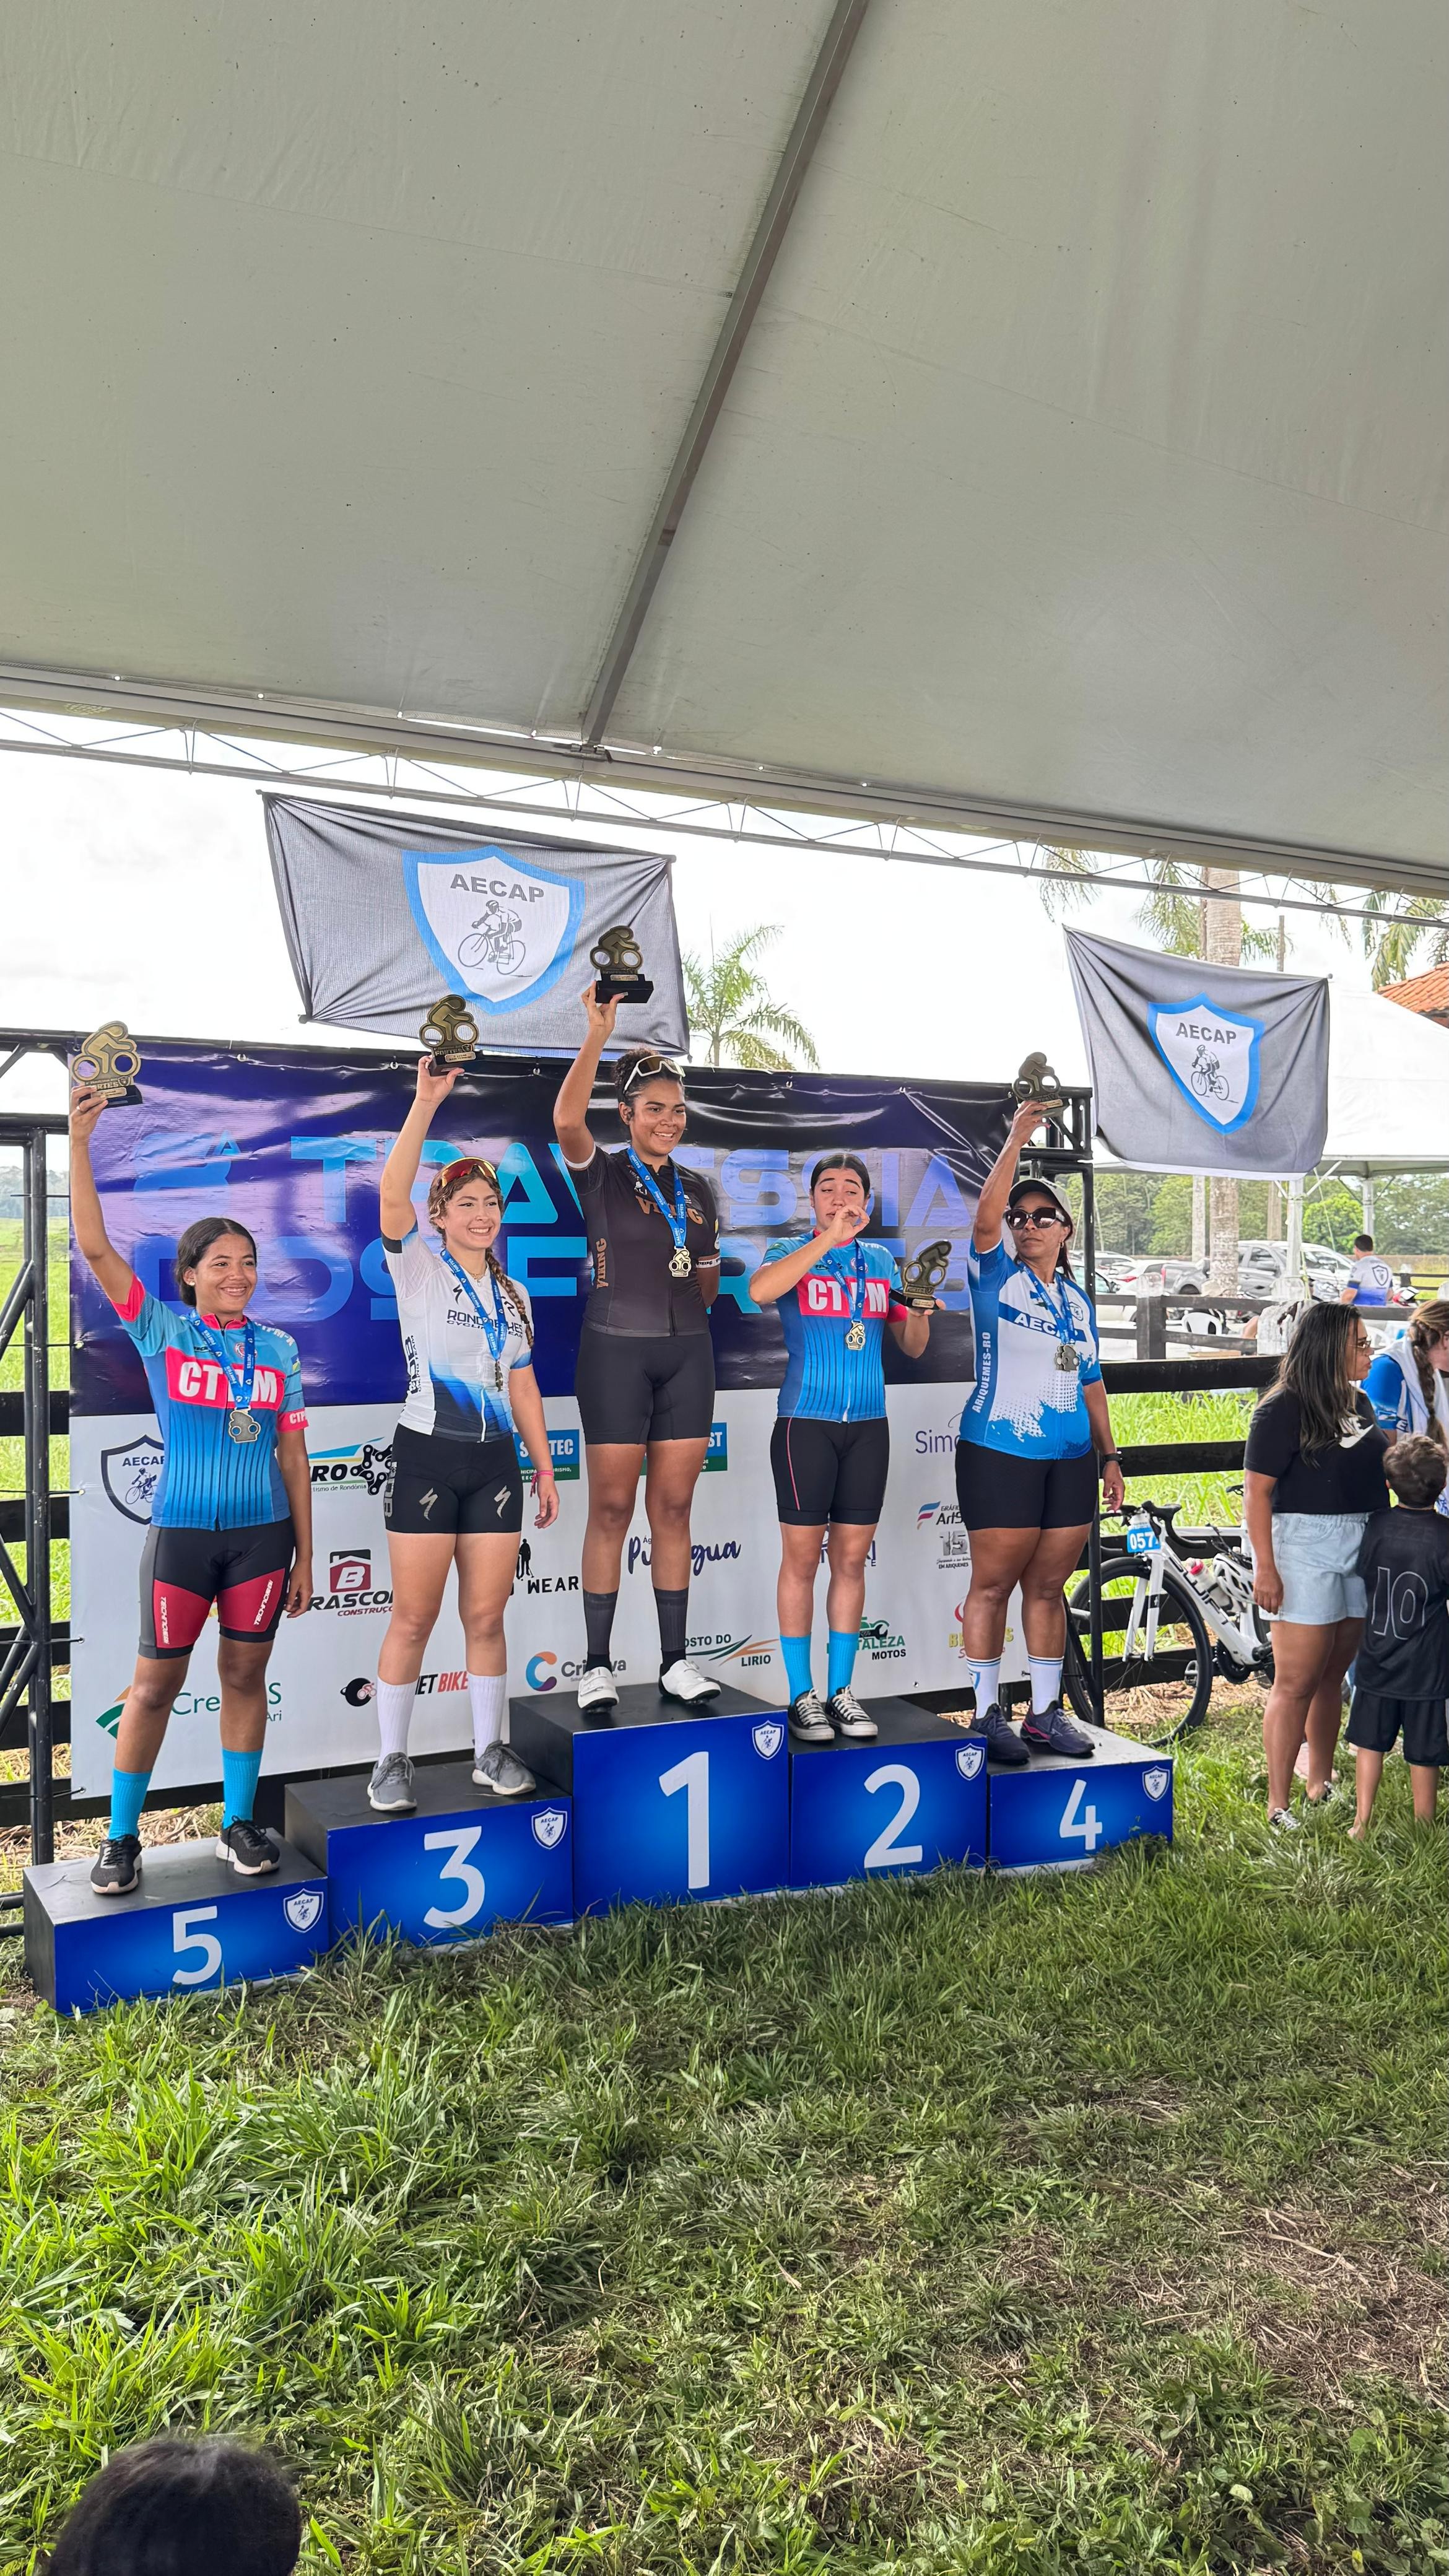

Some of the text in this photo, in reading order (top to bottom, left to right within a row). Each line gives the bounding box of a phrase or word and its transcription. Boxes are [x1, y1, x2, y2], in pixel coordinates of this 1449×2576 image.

[450, 874, 544, 903] AECAP
[1176, 1022, 1237, 1044] AECAP
[972, 1332, 991, 1413] ARIQUEMES-RO
[1129, 1531, 1155, 1550] 057
[336, 1566, 365, 1589] B
[528, 1576, 579, 1595] WEAR
[1372, 1567, 1429, 1640] 10
[716, 1634, 731, 1644] DO
[741, 1655, 771, 1666] LIRIO
[872, 1649, 906, 1660] MOTOS
[438, 1671, 468, 1693] BIKE
[659, 1751, 709, 1889] 1
[863, 1764, 923, 1869] 2
[1059, 1779, 1102, 1850] 4
[423, 1825, 485, 1928] 3
[294, 1898, 314, 1906] AECAP
[173, 1906, 222, 1984] 5
